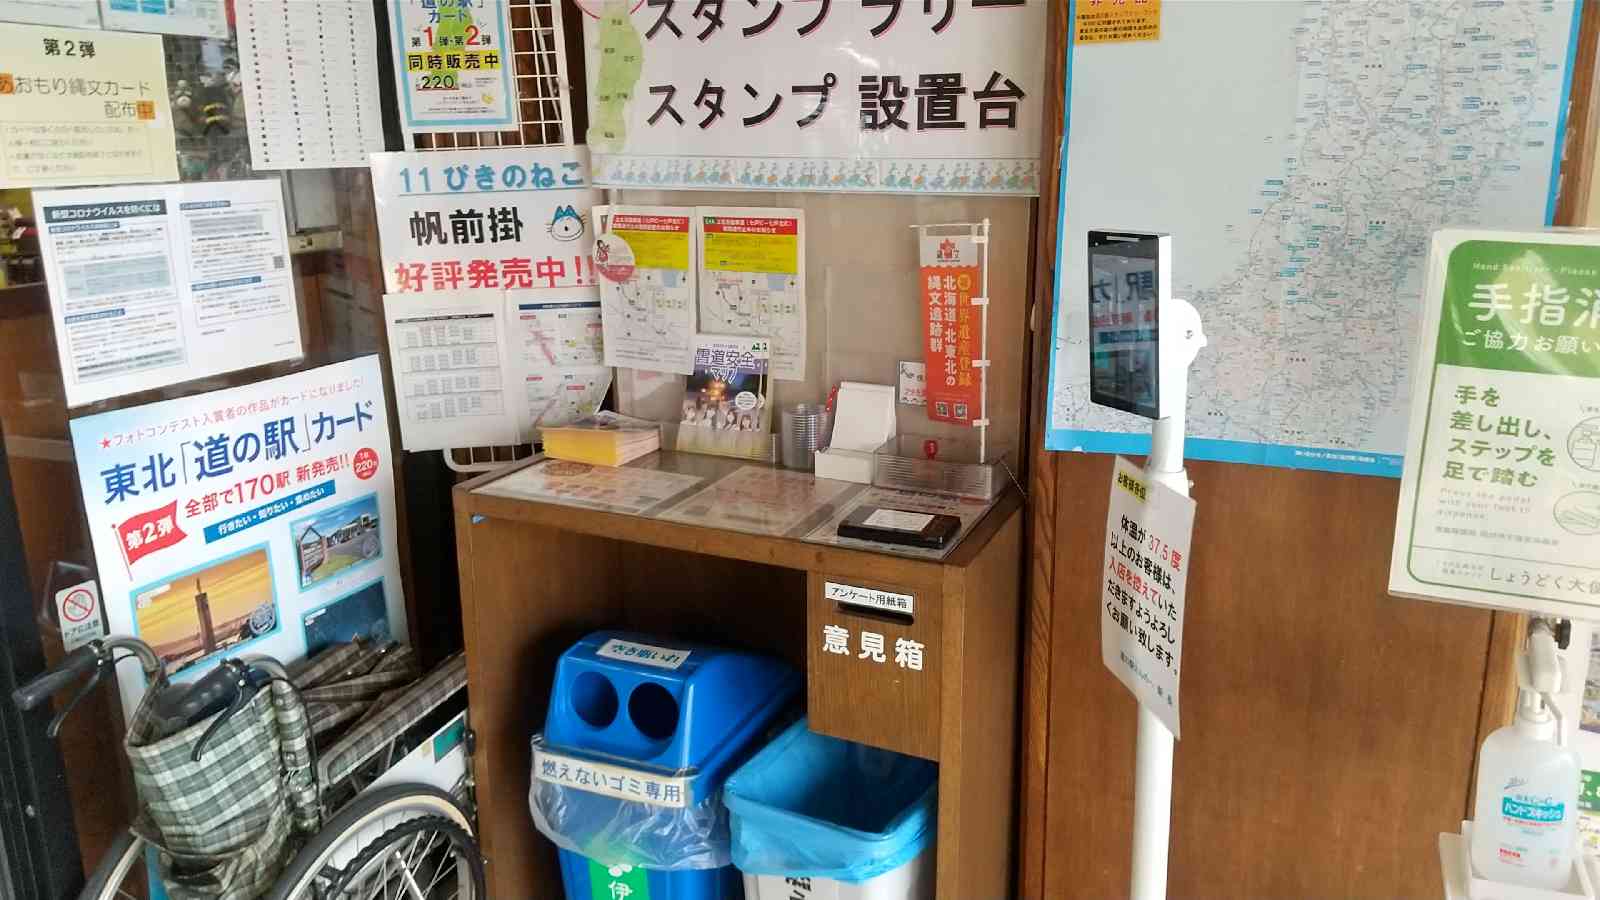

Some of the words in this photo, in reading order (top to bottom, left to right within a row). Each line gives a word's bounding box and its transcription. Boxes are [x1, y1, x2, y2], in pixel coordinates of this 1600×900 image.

[43, 37, 96, 59] 第2弾
[408, 53, 499, 70] 同時販売中
[104, 100, 154, 120] 配布中
[647, 72, 837, 129] スタンプ
[858, 70, 1026, 131] 設置台
[409, 206, 524, 246] 帆前掛
[1454, 385, 1500, 407] 手を
[1449, 410, 1552, 440] 差し出し、
[100, 400, 375, 506] 東北「道の駅」カード
[1447, 438, 1556, 467] ステップを
[1442, 461, 1539, 488] 足で踏む
[126, 517, 175, 549] 第2弾
[1121, 514, 1147, 547] 体温が
[831, 587, 908, 608] アンケート用紙箱
[823, 624, 925, 671] 意見箱
[542, 758, 681, 802] 燃えないゴミ専用
